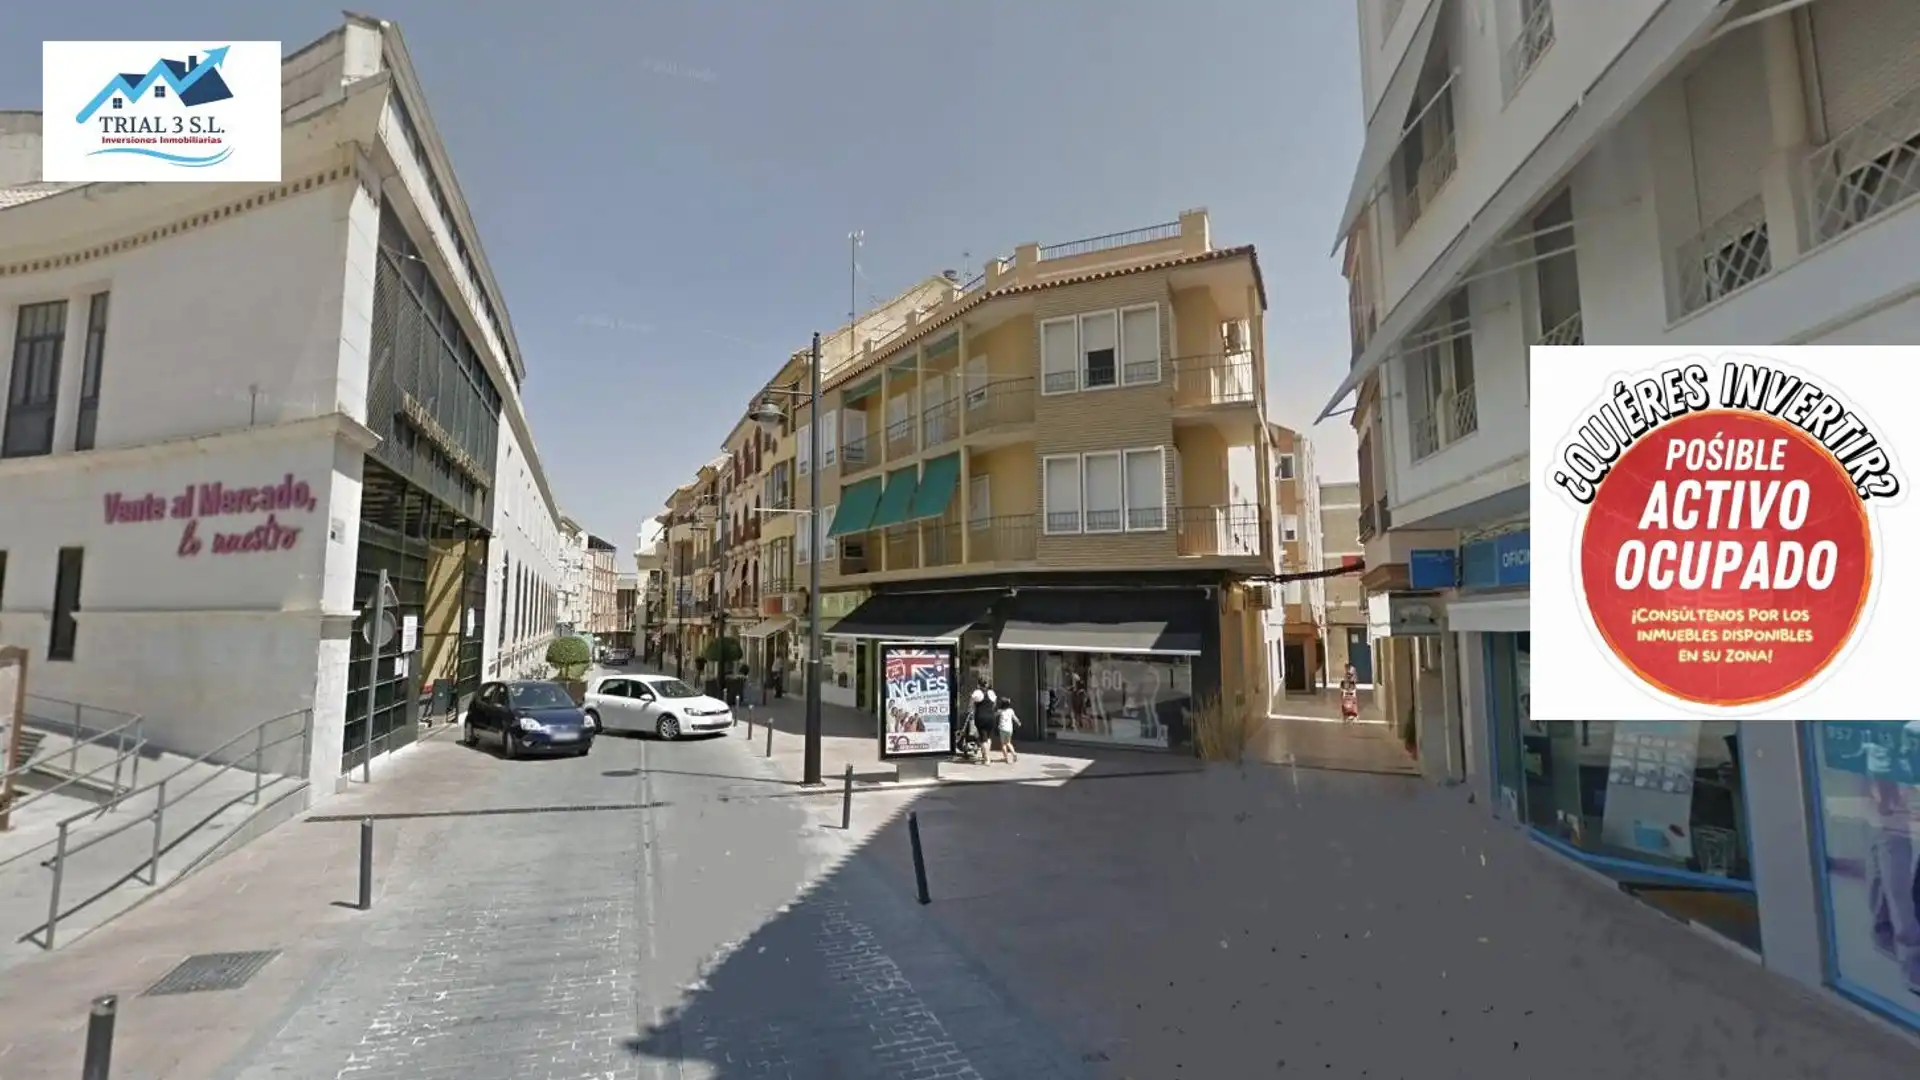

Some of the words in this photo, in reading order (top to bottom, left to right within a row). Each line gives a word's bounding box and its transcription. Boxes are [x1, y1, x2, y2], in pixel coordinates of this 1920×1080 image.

[170, 485, 194, 519] al
[198, 473, 317, 517] Mercado,
[177, 519, 203, 557] lo
[211, 514, 303, 553] nuestro
[888, 674, 949, 700] INGLÉS
